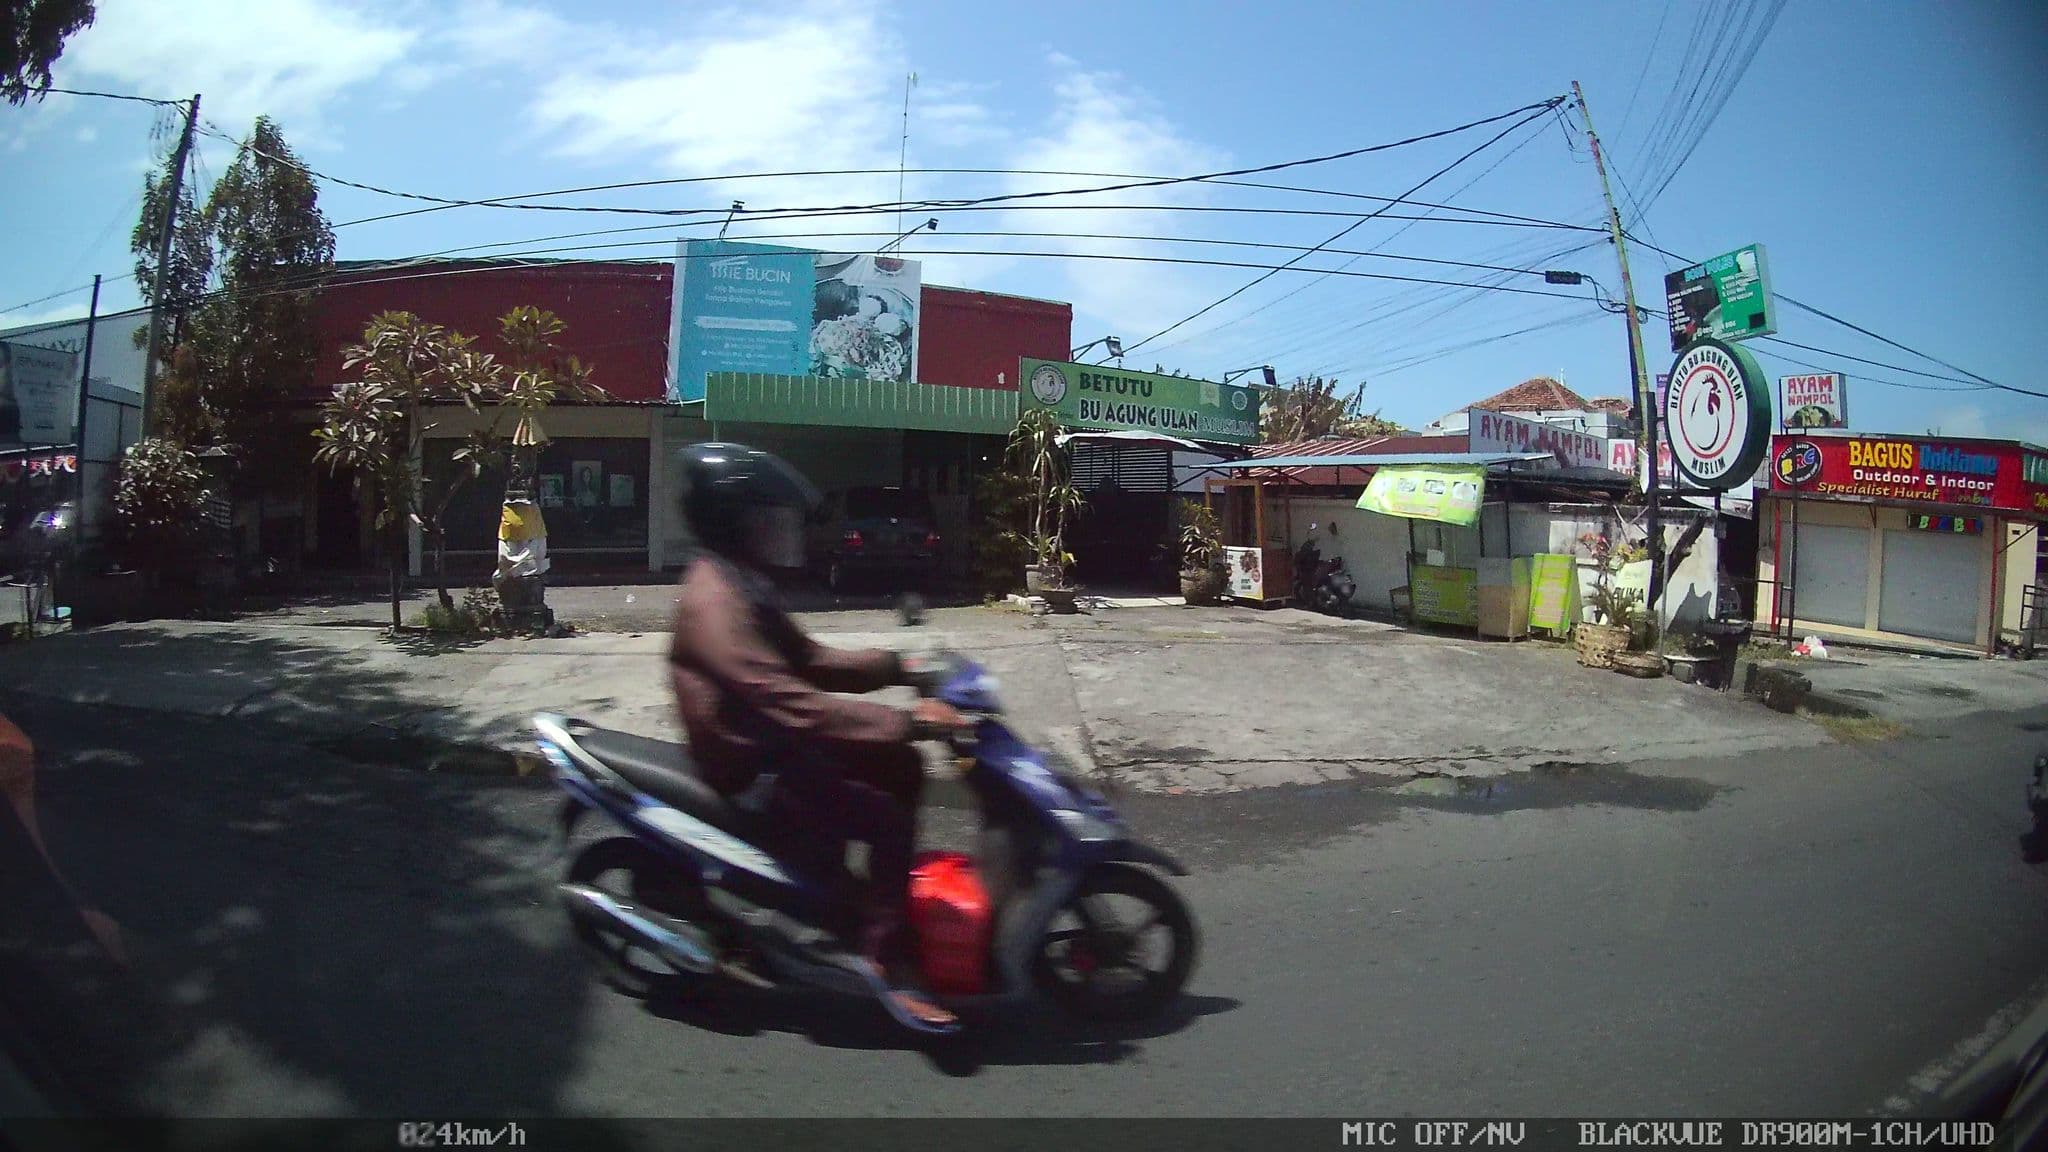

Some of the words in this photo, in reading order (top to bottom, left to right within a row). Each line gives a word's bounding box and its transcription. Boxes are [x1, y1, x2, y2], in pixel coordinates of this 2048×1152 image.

[746, 267, 791, 284] BUCIN
[1080, 372, 1153, 397] BETUTU
[1670, 364, 1689, 409] BETUTU
[1687, 355, 1701, 372] BU
[1701, 350, 1729, 373] AGUNG
[1787, 375, 1833, 394] AYAM
[1787, 393, 1835, 406] NAMPOL
[1079, 399, 1101, 422] BU
[1105, 403, 1156, 428] AGUNG
[1161, 408, 1200, 433] ULAN
[1202, 416, 1256, 438] MUSLIM
[1480, 414, 1530, 447] AYAM
[1691, 455, 1726, 475] MUSLIM
[1848, 441, 1914, 469] BAGUS
[1817, 481, 1890, 499] Specialist
[1894, 485, 1940, 501] Huruf
[1853, 469, 1920, 486] Outdoor
[1926, 474, 1936, 486] &
[1942, 474, 1995, 492] Indoor
